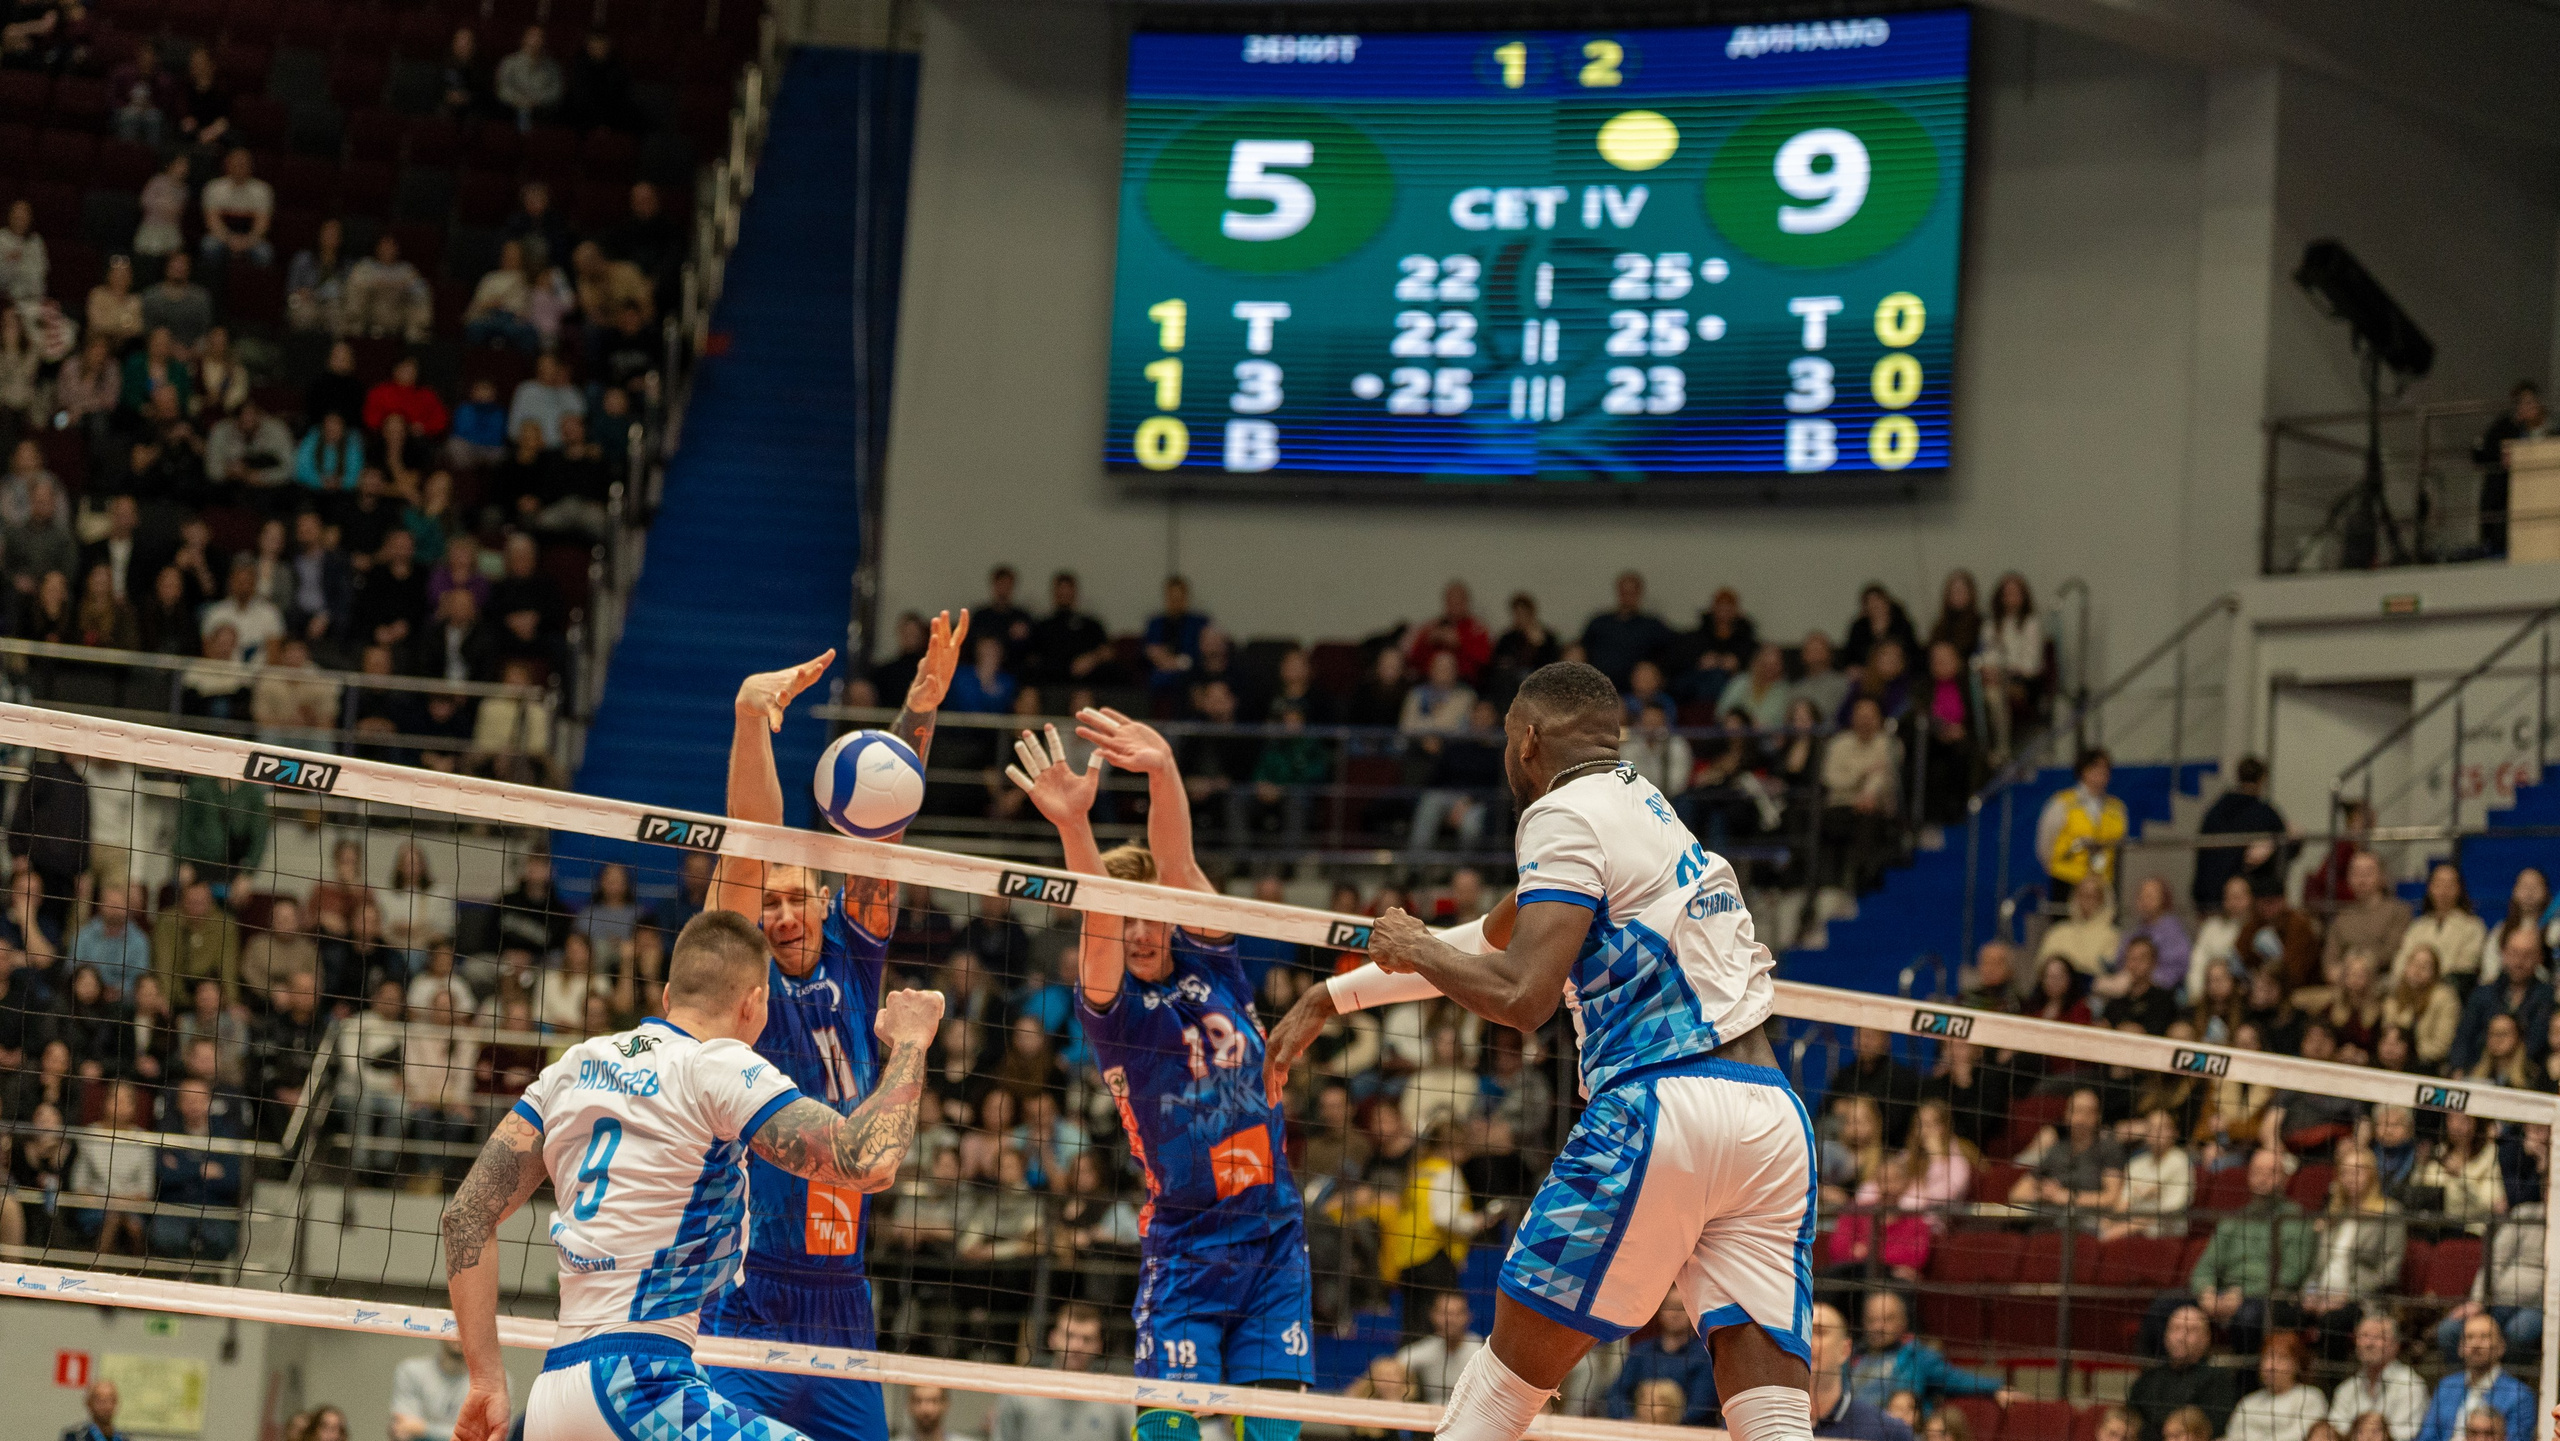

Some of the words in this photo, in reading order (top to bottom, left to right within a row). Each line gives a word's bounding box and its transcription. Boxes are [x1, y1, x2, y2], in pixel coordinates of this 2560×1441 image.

[1241, 34, 1362, 64] ЗЕНИТ
[1725, 17, 1891, 60] ДИНАМО
[1493, 40, 1527, 90] 1
[1578, 39, 1624, 88] 2
[1221, 139, 1316, 242] 5
[1773, 127, 1872, 235] 9
[1582, 184, 1650, 230] IV
[1395, 253, 1481, 302] 22
[1608, 252, 1693, 300] 25
[1148, 298, 1187, 353] 1
[1390, 310, 1478, 358] 22
[1605, 309, 1690, 357] 25
[1873, 291, 1926, 348] 0
[1144, 356, 1184, 412] 1
[1386, 366, 1473, 416] 25
[1601, 366, 1687, 415] 23
[1870, 352, 1923, 410] 0
[1133, 415, 1190, 471] 0
[1867, 413, 1920, 471] 0
[252, 755, 333, 789] PARI
[644, 818, 719, 848] PARI
[1004, 873, 1072, 903] PARI
[1333, 924, 1371, 948] PA
[1182, 1012, 1247, 1081] 18
[1915, 1012, 1971, 1038] PARI
[2175, 1051, 2228, 1076] PARI
[573, 1117, 622, 1222] 9
[1163, 1339, 1198, 1369] 18
